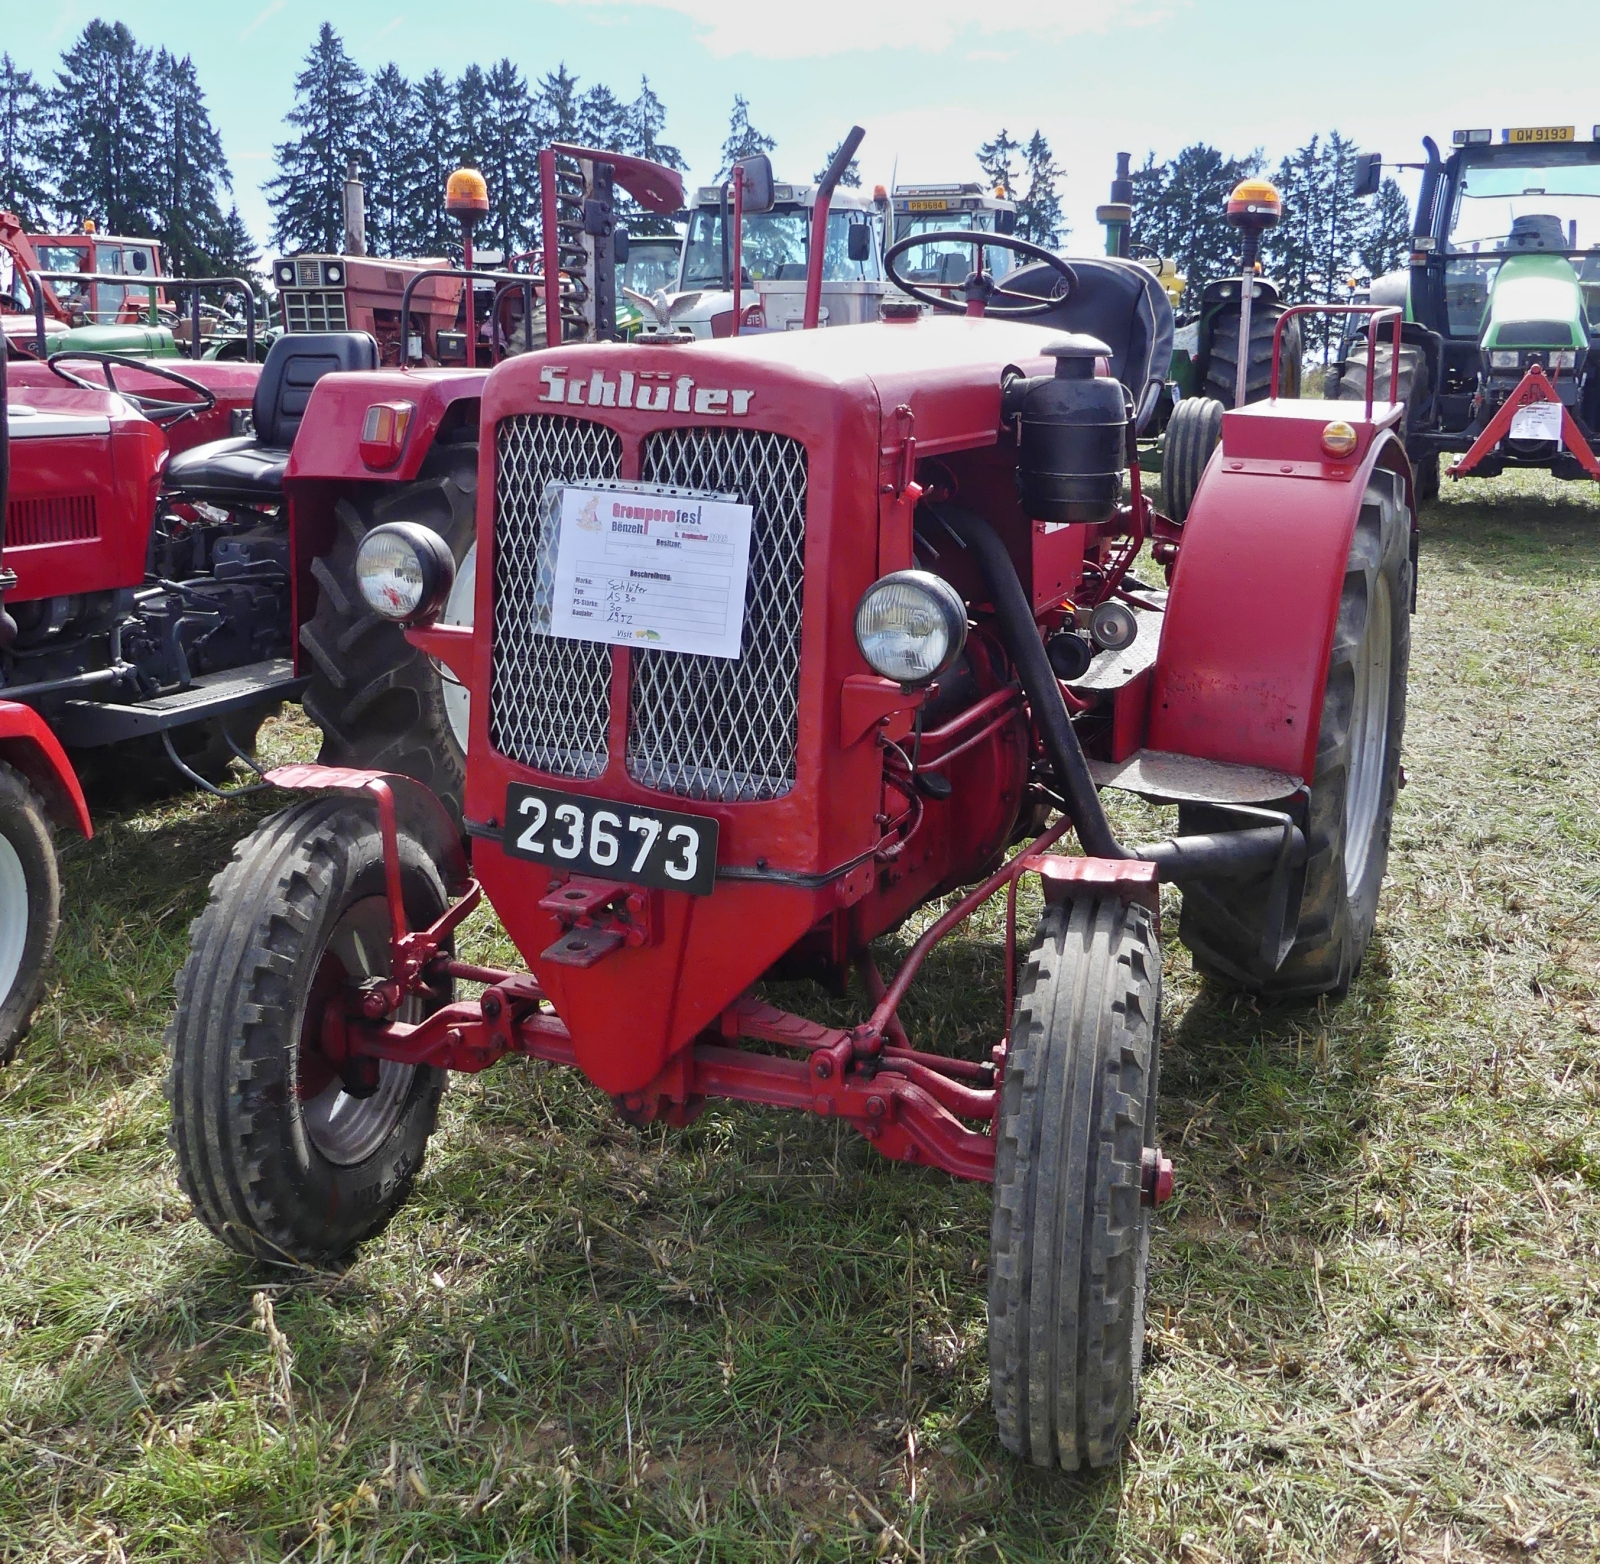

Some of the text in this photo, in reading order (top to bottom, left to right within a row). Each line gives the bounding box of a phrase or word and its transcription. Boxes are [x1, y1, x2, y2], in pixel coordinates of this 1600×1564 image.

[1517, 128, 1567, 141] QW 9193
[911, 201, 942, 210] PR 9684
[538, 366, 754, 416] Schlüter
[624, 593, 637, 603] 30
[609, 602, 622, 612] 30
[516, 796, 700, 881] 23673
